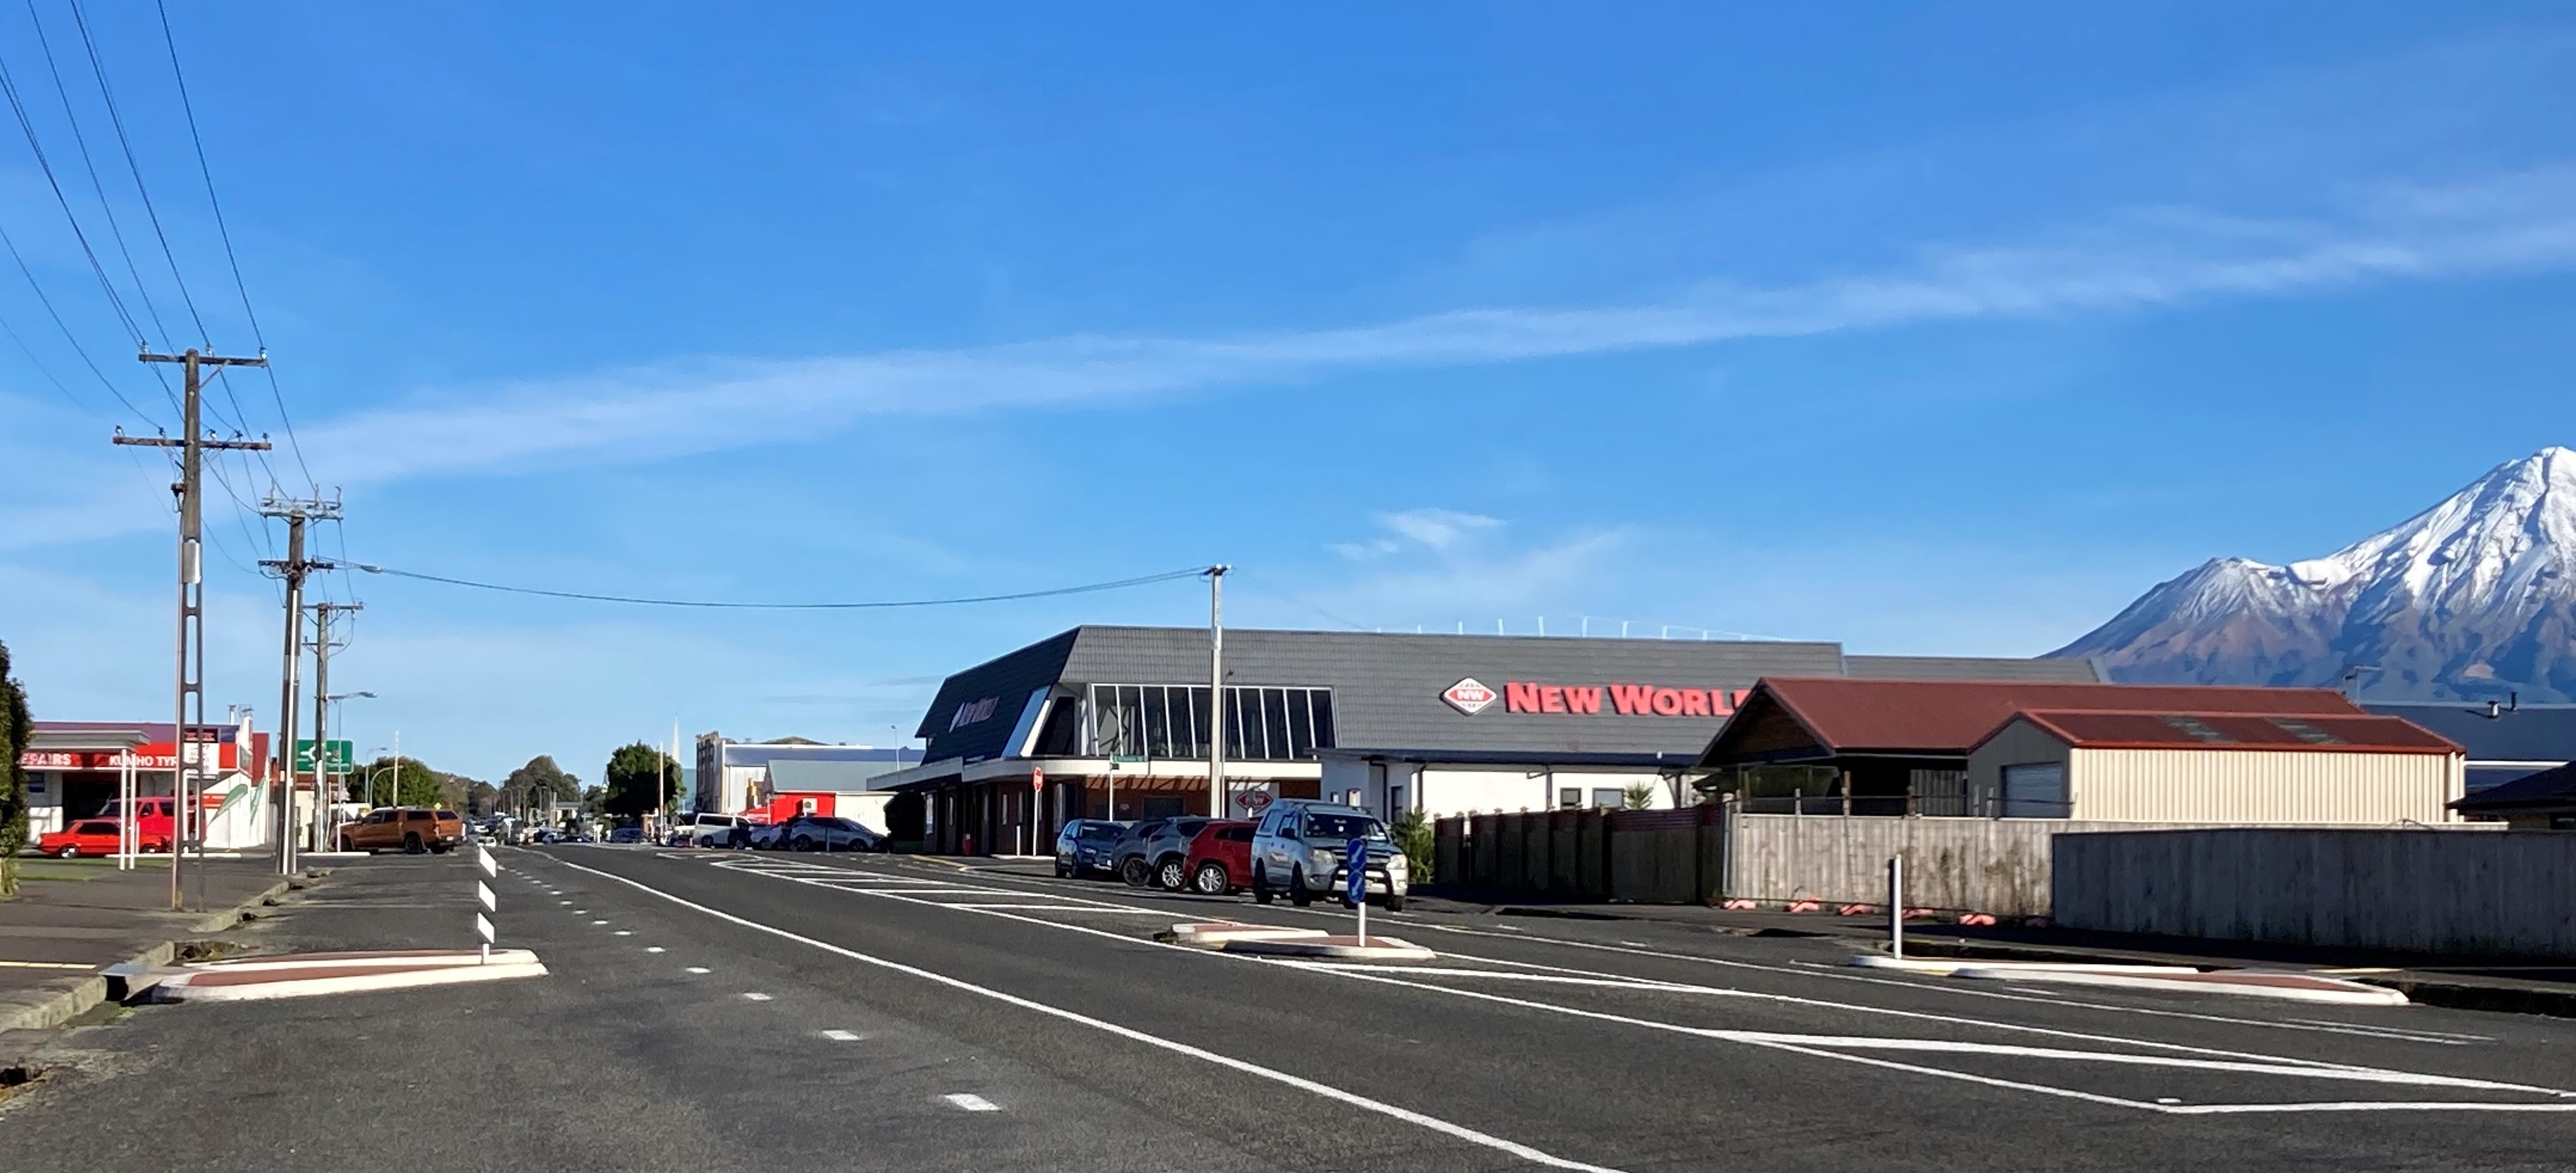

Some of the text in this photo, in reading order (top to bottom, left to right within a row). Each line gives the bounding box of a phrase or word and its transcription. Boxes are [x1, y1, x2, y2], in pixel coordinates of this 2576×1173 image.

[1457, 690, 1484, 701] NW
[1505, 681, 1601, 714] NEW
[16, 752, 72, 766] EPAIRS
